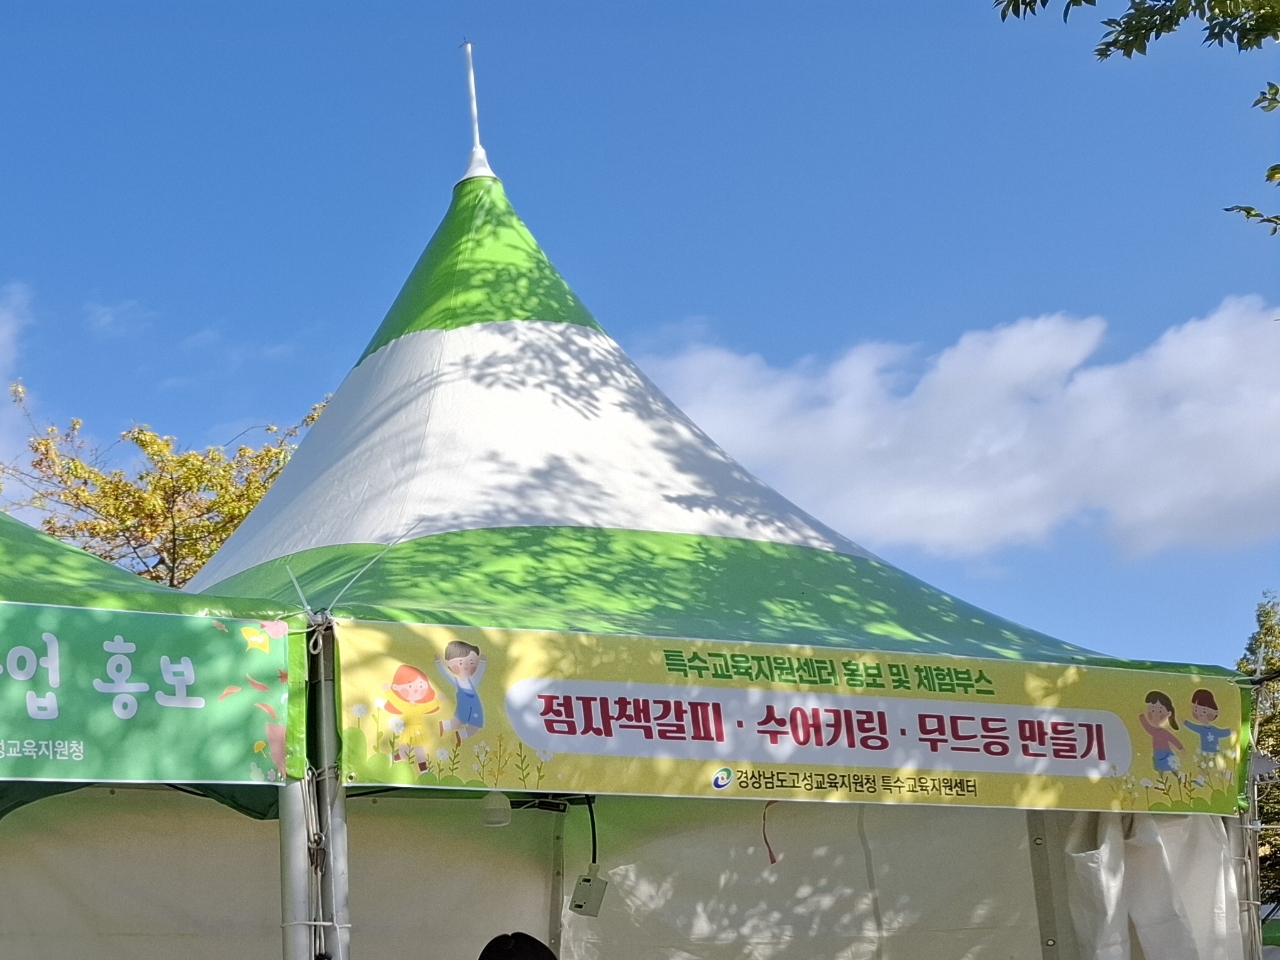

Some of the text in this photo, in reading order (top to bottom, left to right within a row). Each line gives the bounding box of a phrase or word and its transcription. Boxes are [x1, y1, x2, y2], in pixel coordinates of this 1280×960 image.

[93, 635, 205, 719] 홍보
[663, 650, 995, 696] 특수교육지원센터 홍보 및 체험부스
[537, 694, 1107, 761] 점자책갈피 수어키링 무드등 만들기
[737, 769, 978, 797] 경상남도고성교육지원청 특수교육지원센터
